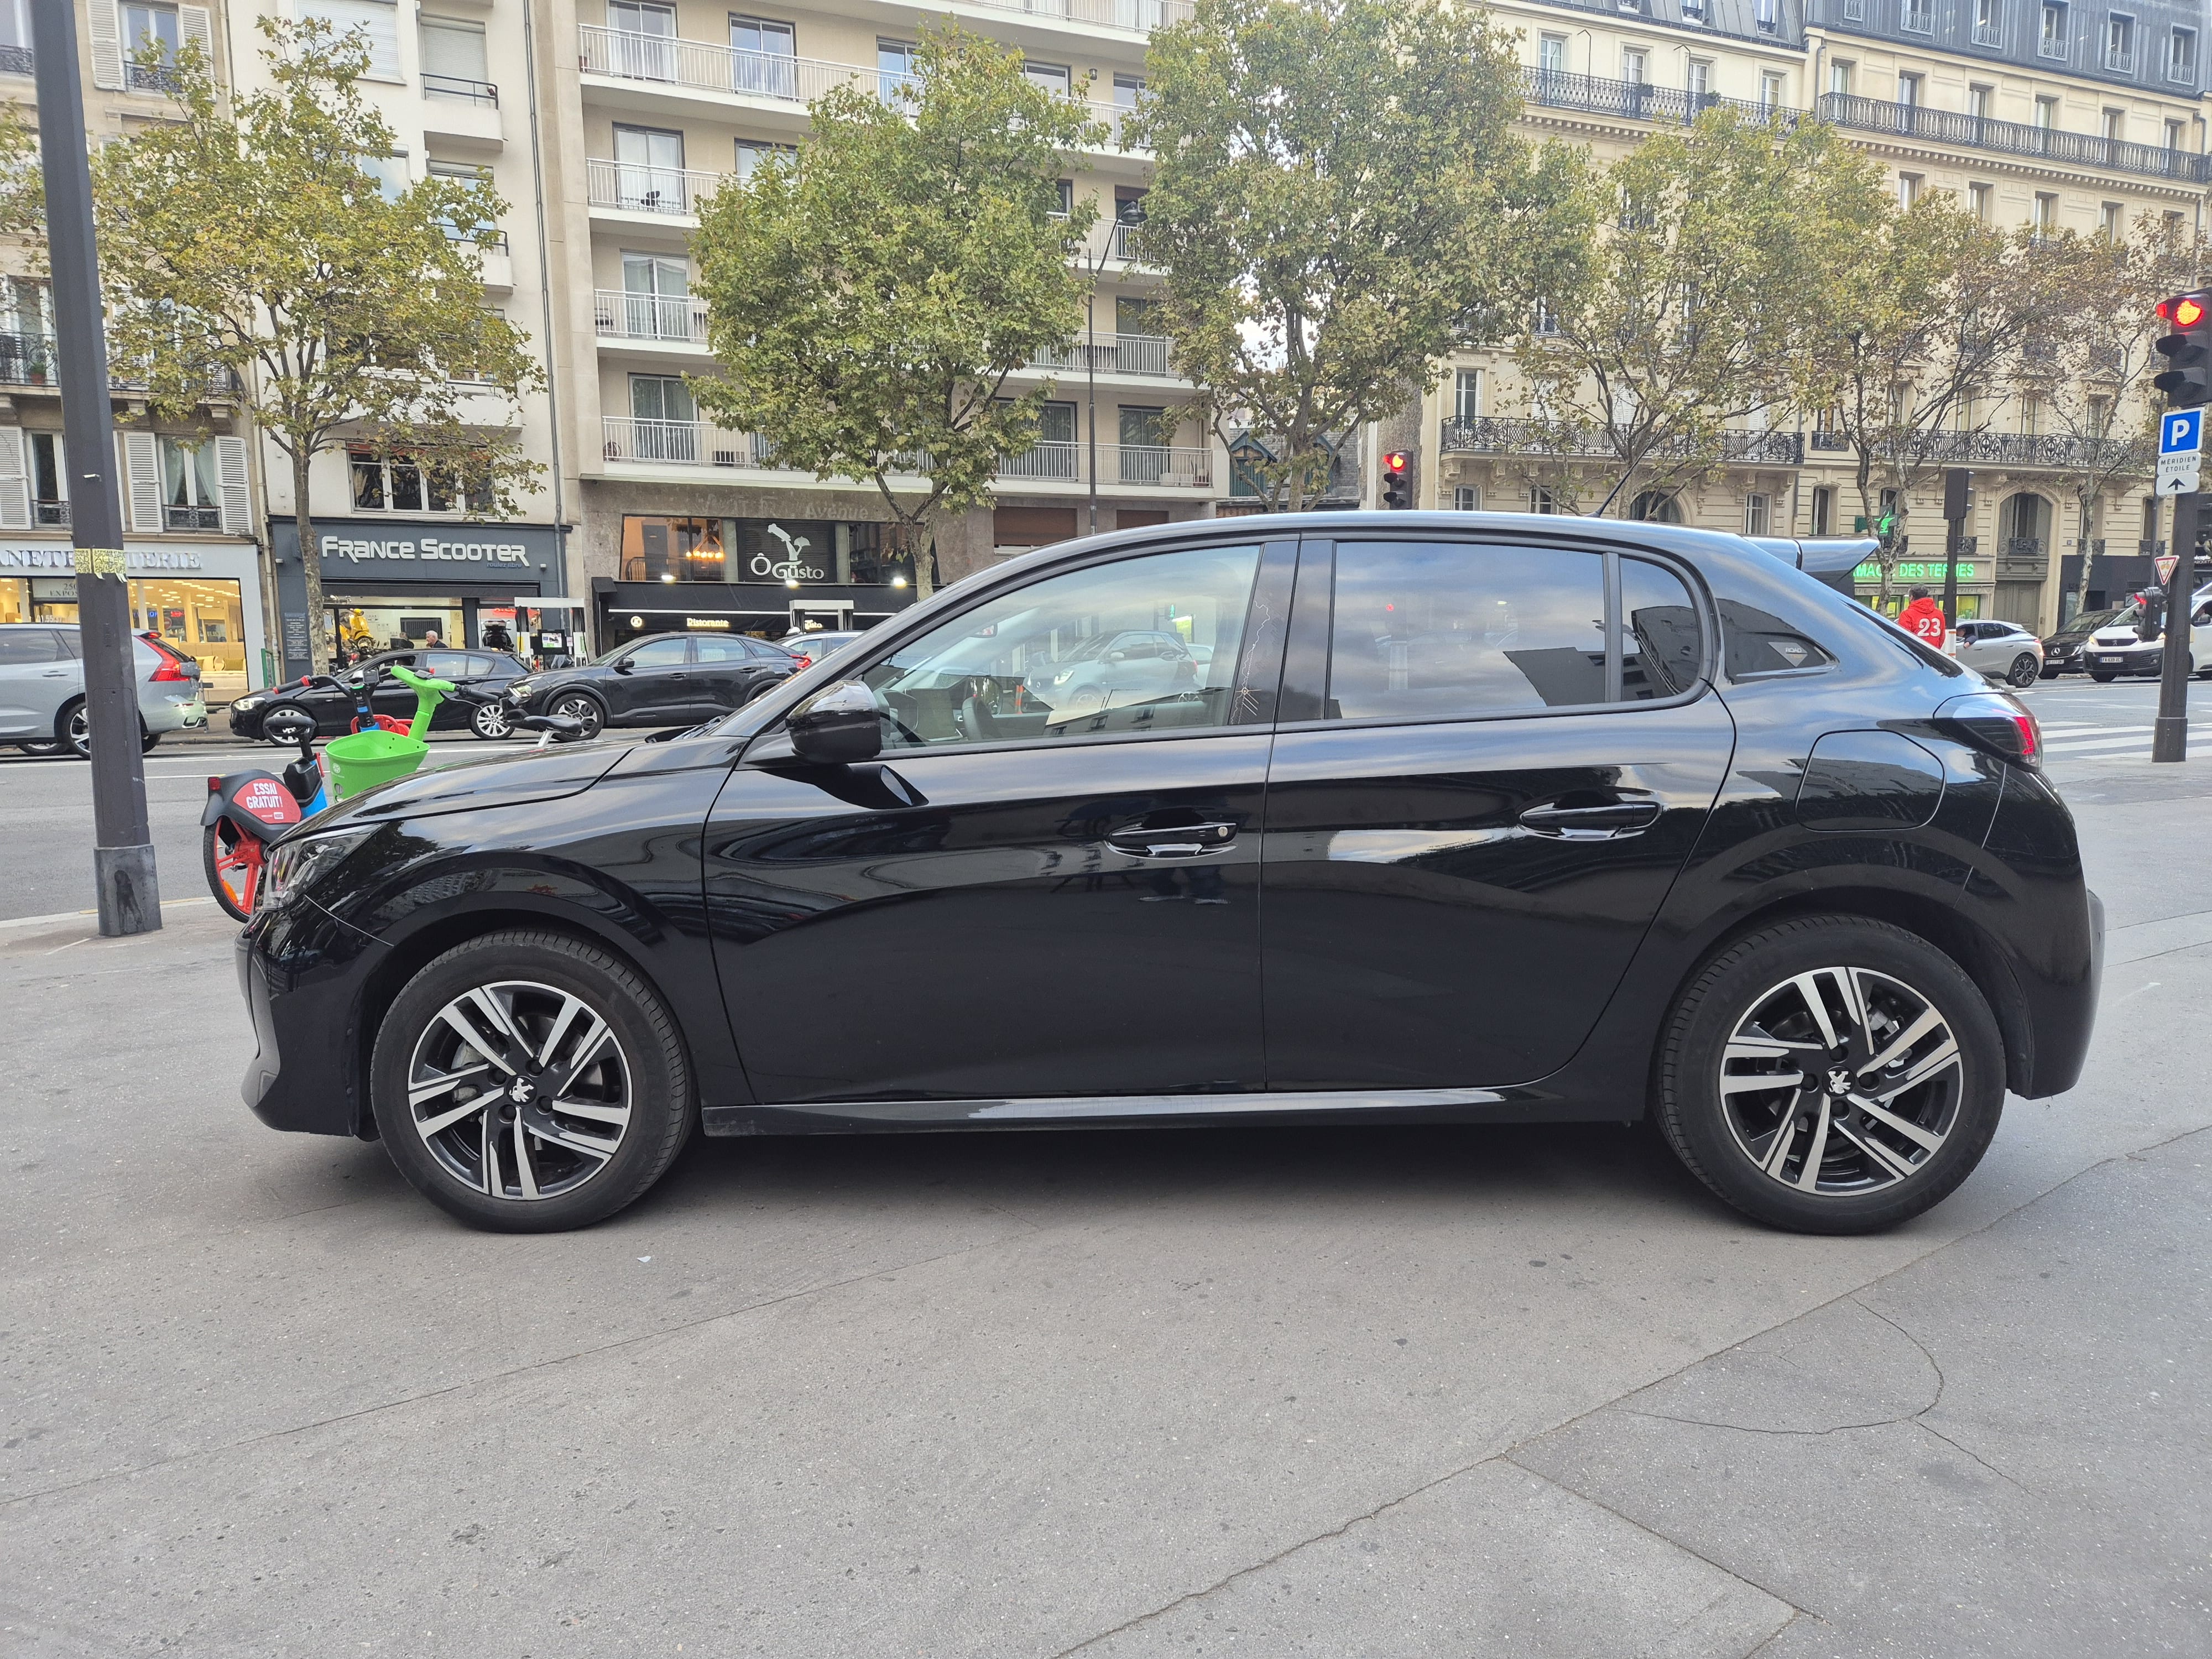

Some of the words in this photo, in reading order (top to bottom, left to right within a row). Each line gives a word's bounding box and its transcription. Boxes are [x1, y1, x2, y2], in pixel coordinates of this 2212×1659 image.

[2171, 419, 2190, 446] P
[2161, 456, 2197, 465] MÉRIDIEN
[2166, 465, 2190, 473] ÉTOILE
[1899, 563, 1924, 577] DES
[1927, 563, 1975, 577] TERES
[686, 617, 730, 628] Ristorante
[1917, 618, 1941, 637] 23
[253, 782, 278, 795] ESSAI
